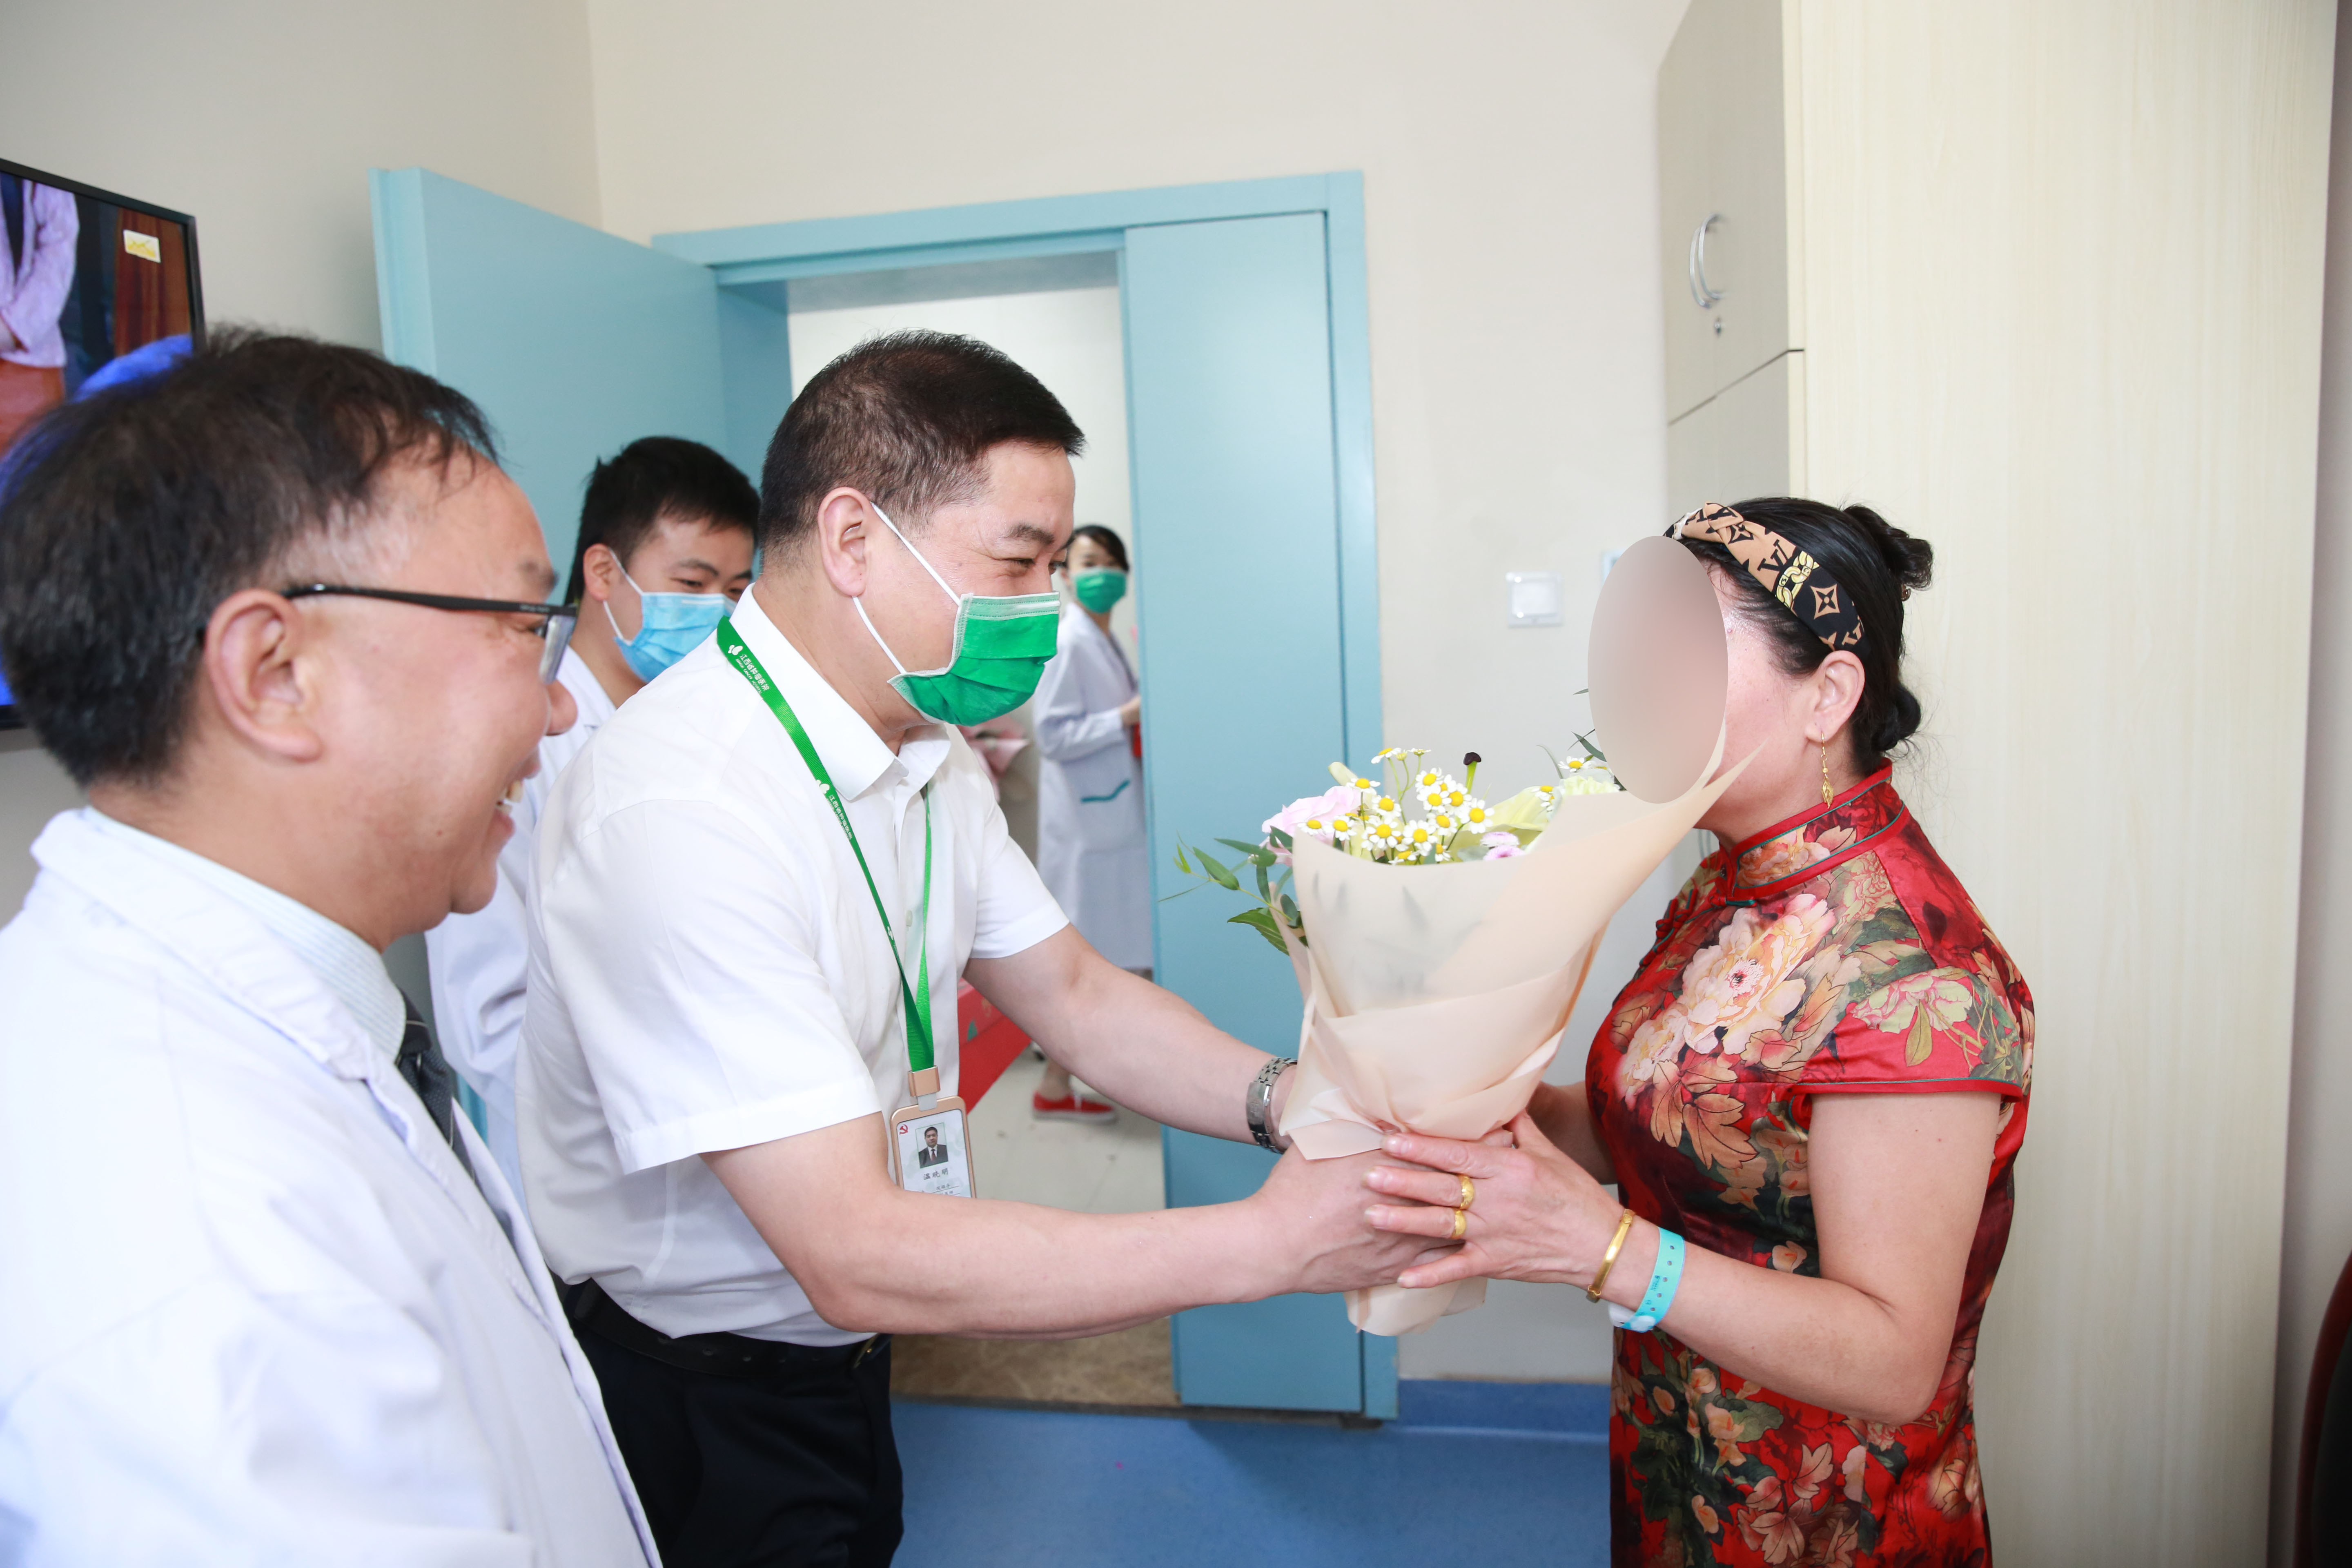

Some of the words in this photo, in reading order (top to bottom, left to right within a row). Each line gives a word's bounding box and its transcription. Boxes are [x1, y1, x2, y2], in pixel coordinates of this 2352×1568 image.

[739, 654, 770, 691] 江西省肿瘤医院
